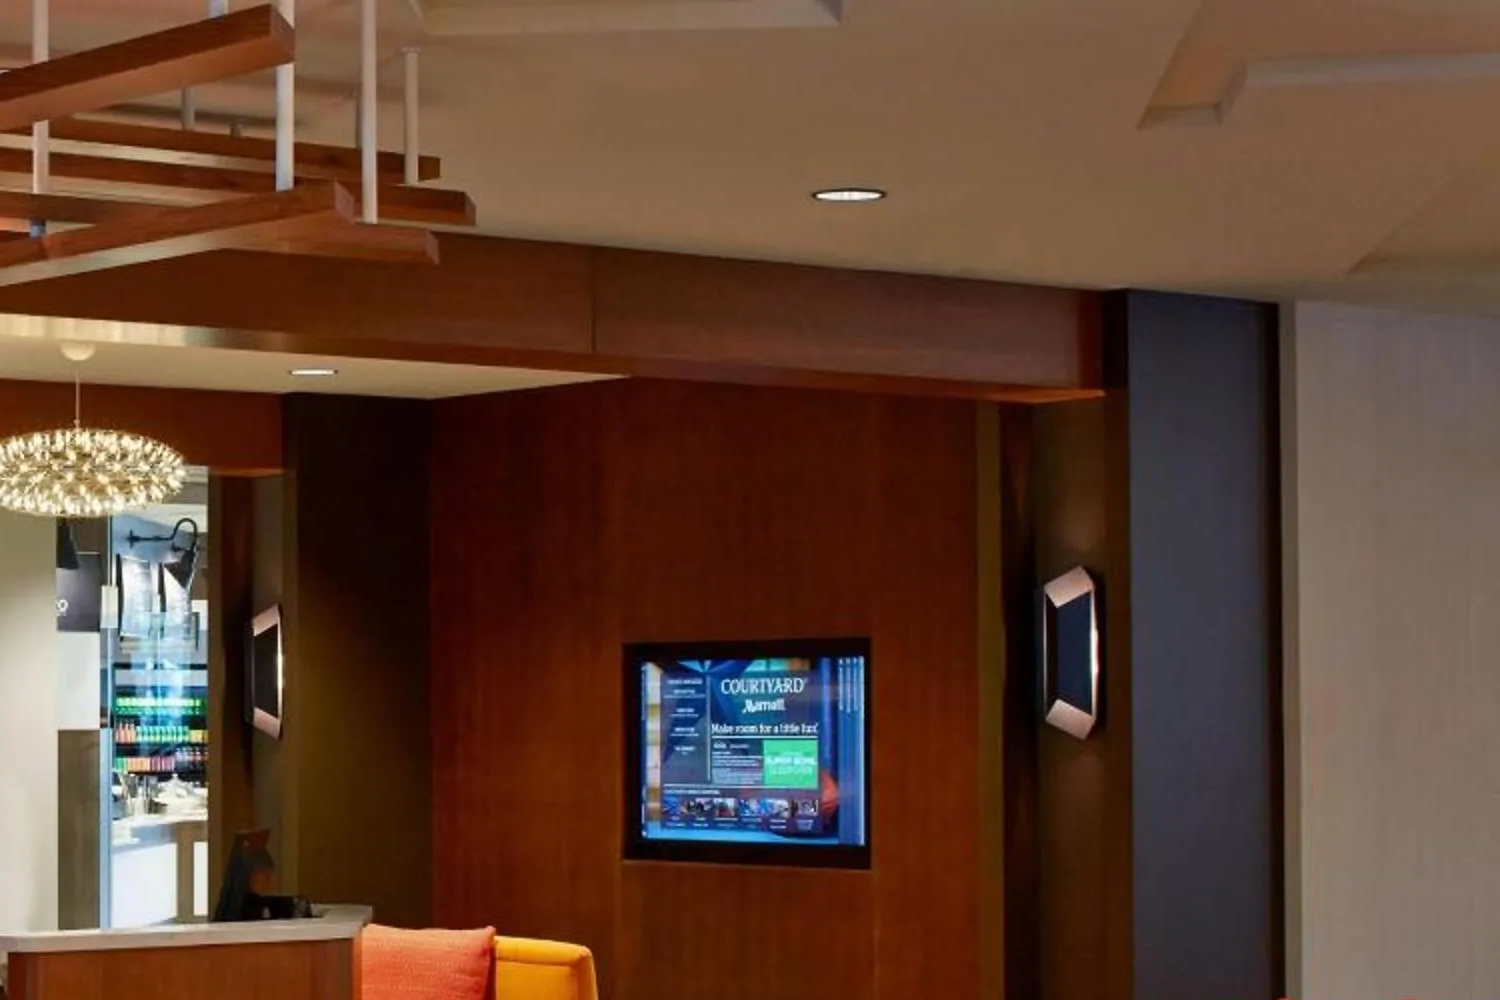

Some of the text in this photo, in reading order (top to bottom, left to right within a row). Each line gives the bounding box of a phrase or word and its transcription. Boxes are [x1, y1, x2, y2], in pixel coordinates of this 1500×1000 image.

[721, 678, 804, 694] COURTYARD
[711, 723, 734, 734] Make
[735, 725, 758, 734] room
[760, 723, 773, 734] for
